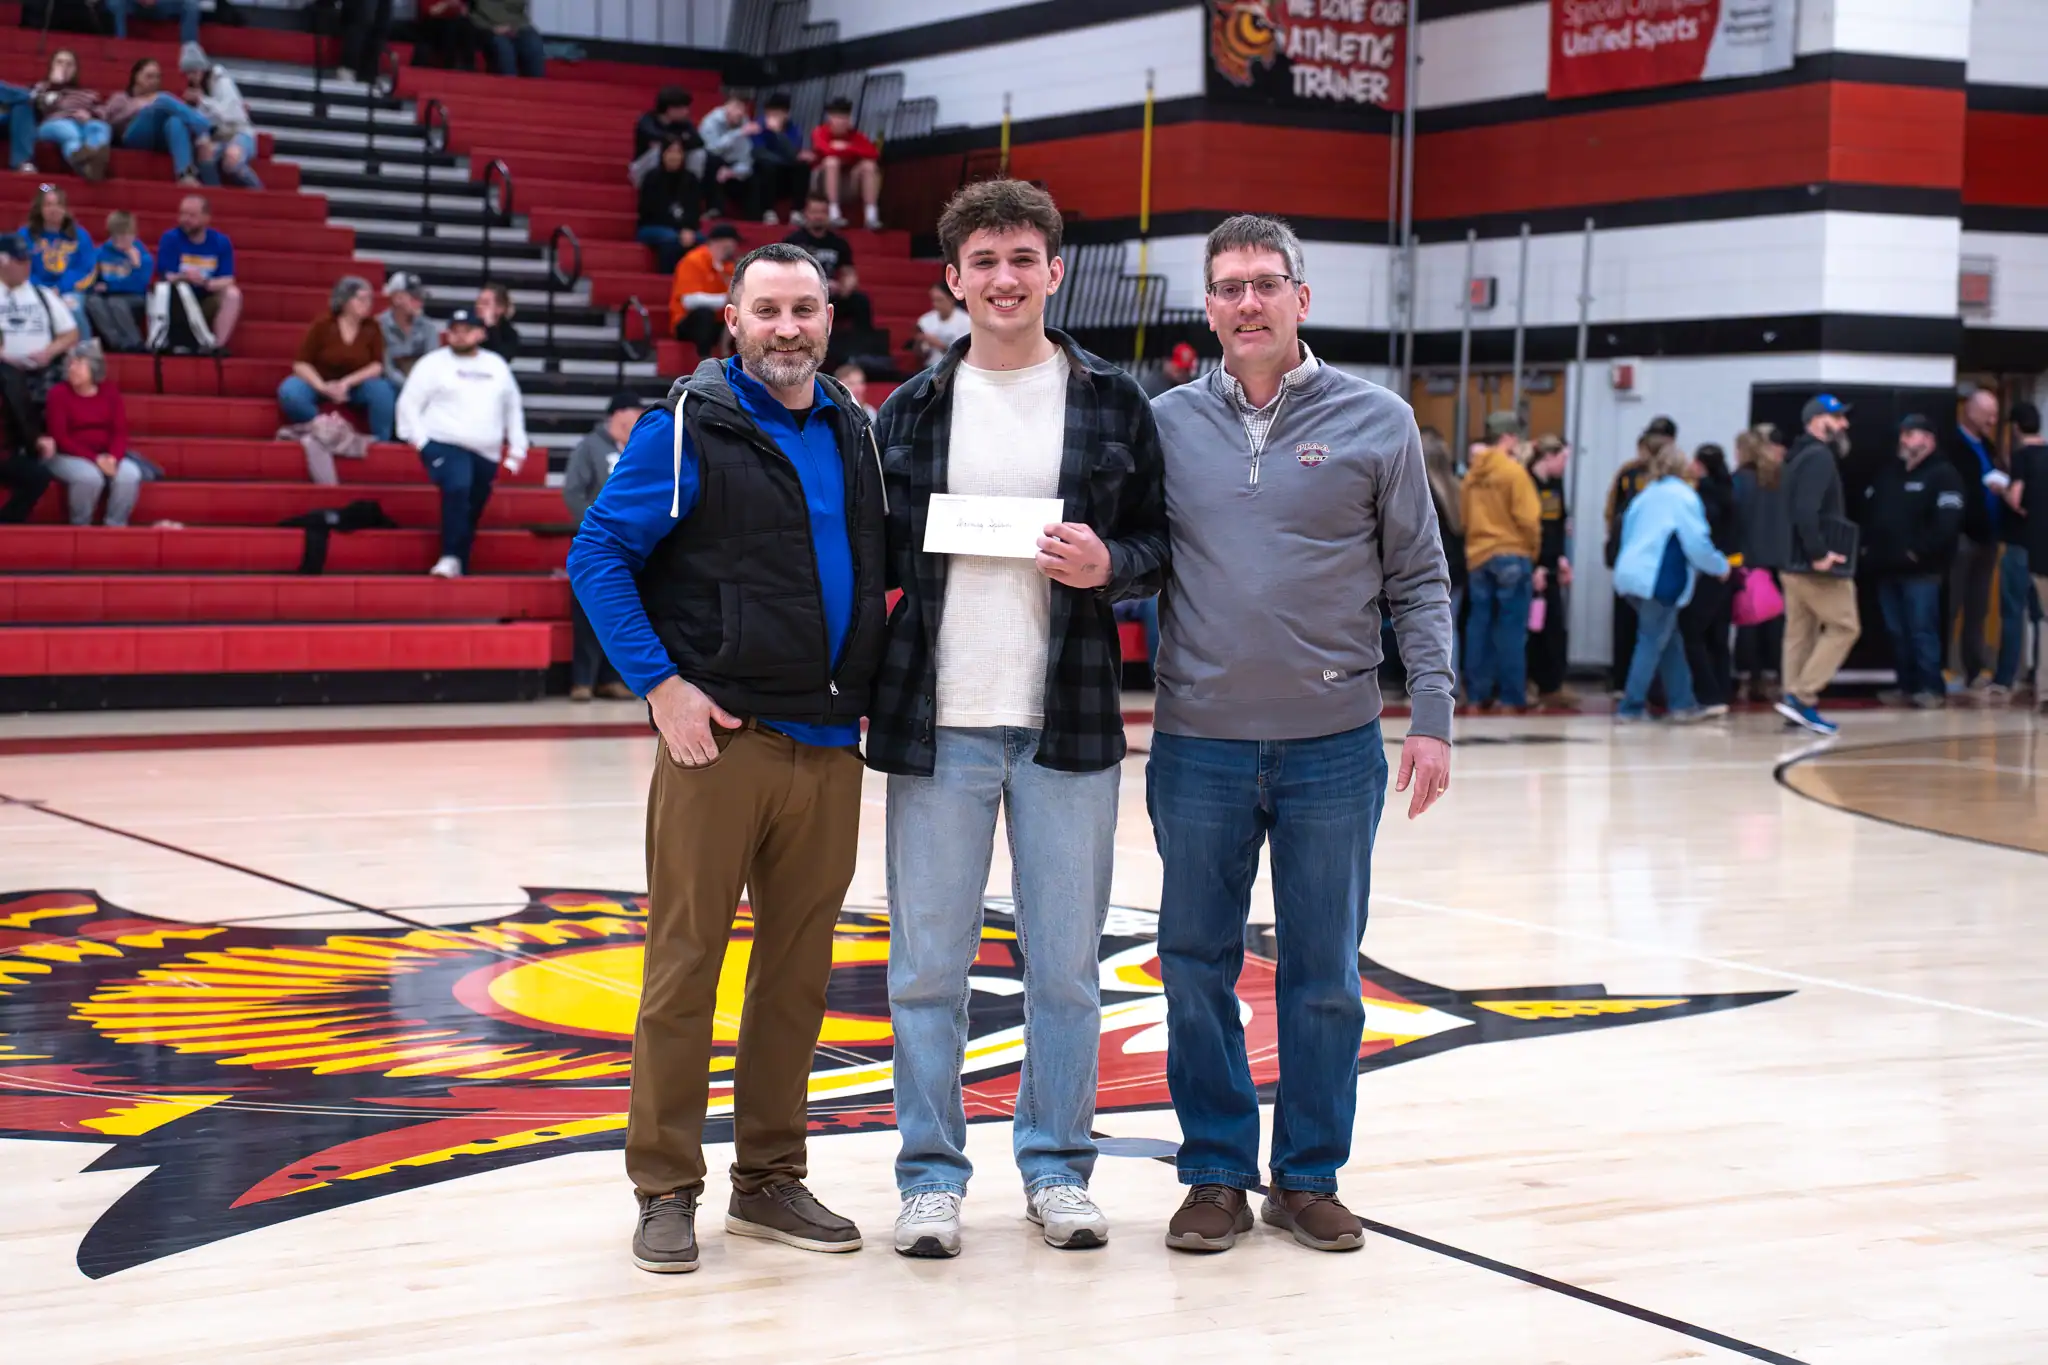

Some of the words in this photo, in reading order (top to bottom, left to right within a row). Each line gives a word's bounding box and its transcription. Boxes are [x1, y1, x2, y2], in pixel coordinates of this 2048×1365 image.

[1286, 25, 1394, 68] ATHLETIC
[1561, 20, 1632, 57] Unified
[1634, 14, 1698, 51] Sports
